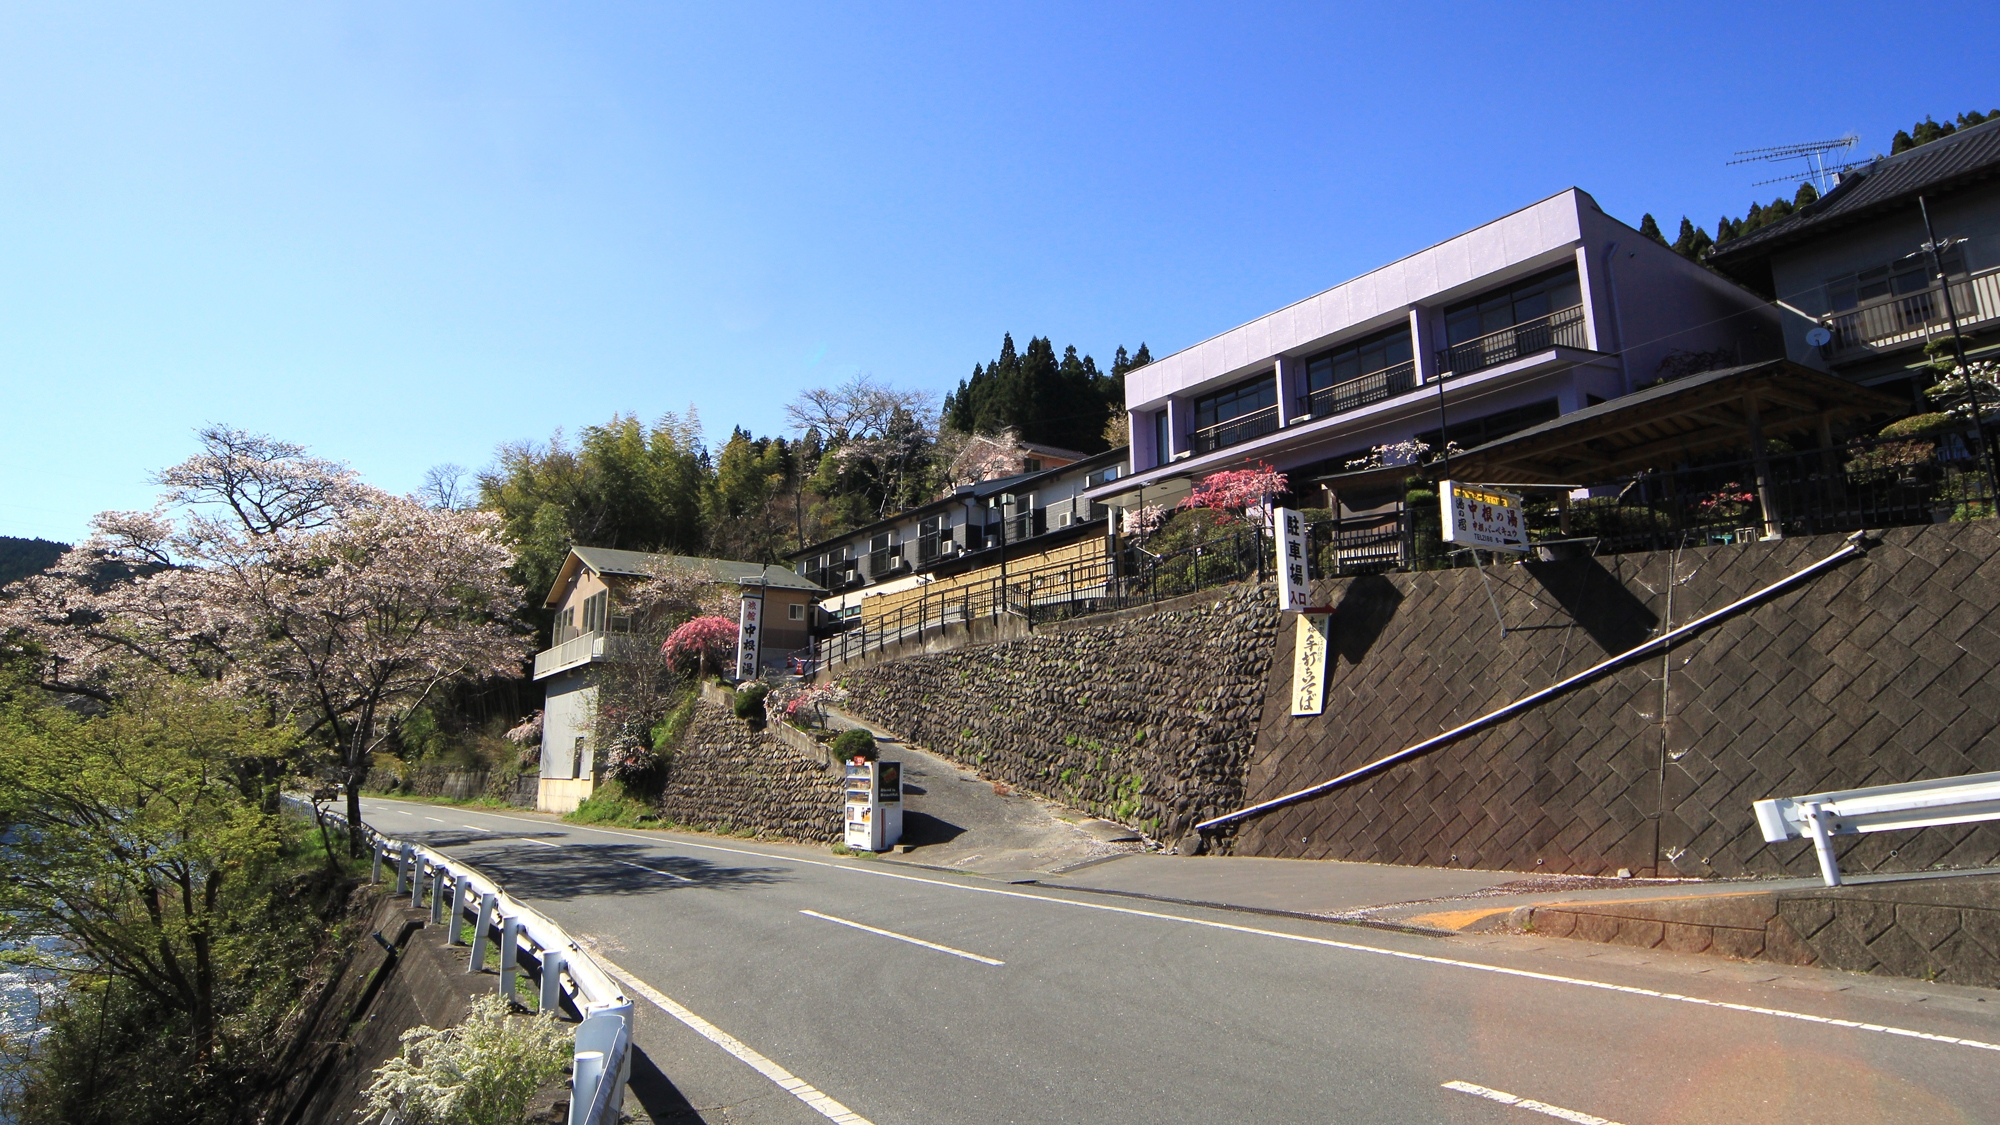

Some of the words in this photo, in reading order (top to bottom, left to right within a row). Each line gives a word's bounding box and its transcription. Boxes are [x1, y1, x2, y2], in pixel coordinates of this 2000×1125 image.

[1468, 500, 1518, 528] 中根の湯
[1287, 515, 1303, 586] 駐車場
[747, 601, 756, 621] 旅館
[1290, 591, 1306, 605] 入口
[742, 623, 756, 676] 中根の湯
